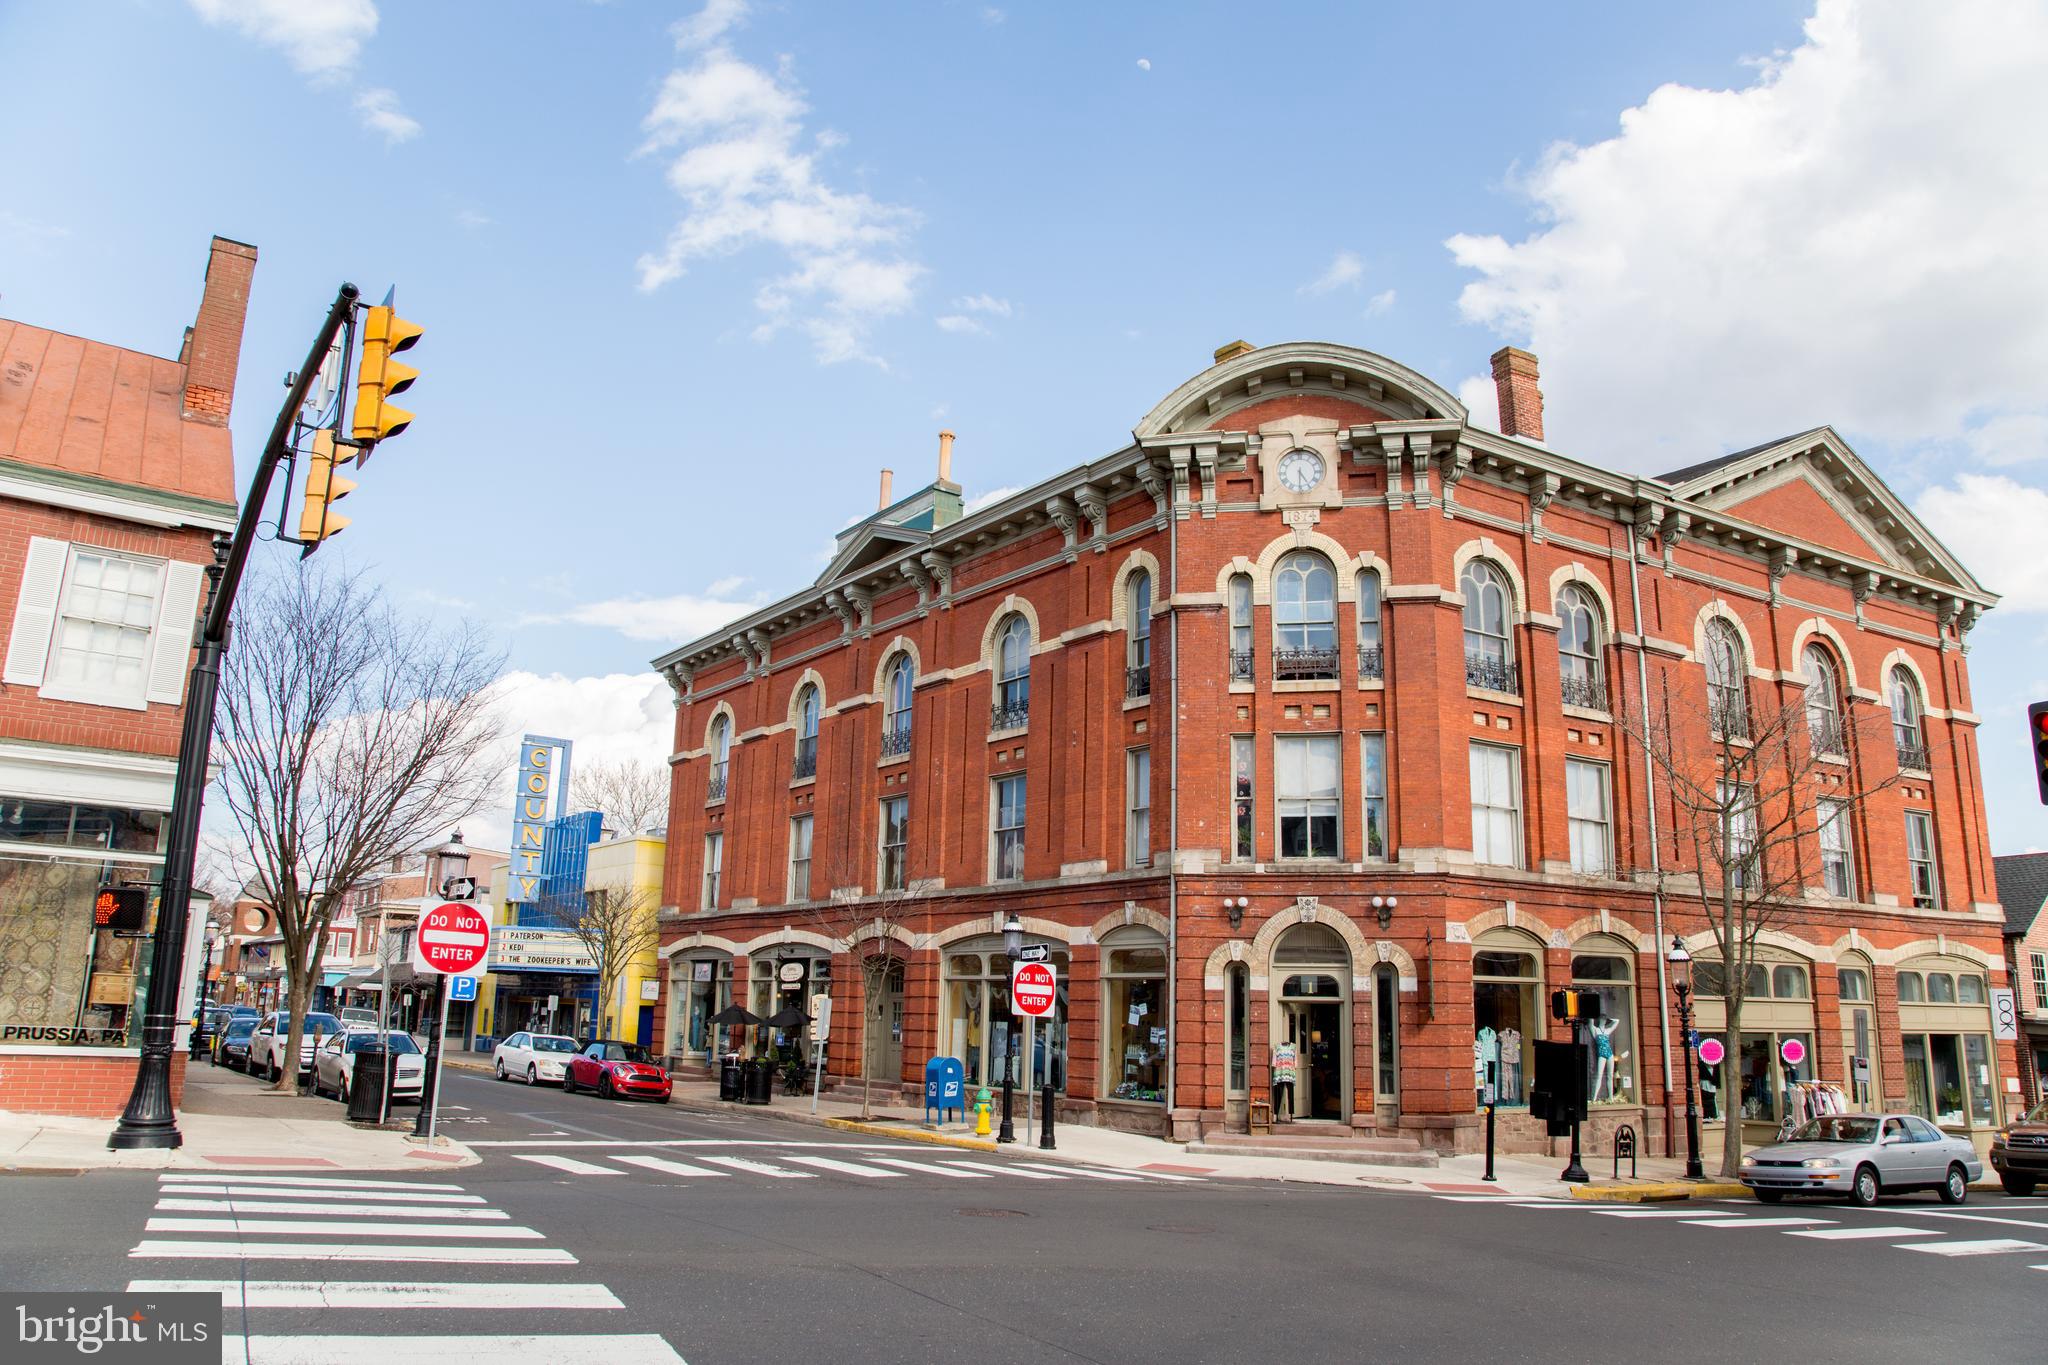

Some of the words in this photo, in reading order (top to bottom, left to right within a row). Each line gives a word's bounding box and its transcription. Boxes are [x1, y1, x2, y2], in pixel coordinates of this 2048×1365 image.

[1288, 511, 1317, 522] 1874
[520, 748, 548, 899] COUNTY
[430, 914, 448, 927] DO
[456, 917, 482, 929] NOT
[510, 932, 544, 940] PATERSON
[509, 943, 524, 951] KEDI
[431, 947, 473, 961] ENTER
[509, 955, 521, 963] THE
[527, 956, 571, 965] ZOOKEEPER'S
[576, 958, 592, 966] WIFE
[1020, 973, 1030, 981] DO
[1035, 974, 1050, 983] NOT
[458, 979, 471, 992] P
[1307, 981, 1314, 994] 1
[1022, 996, 1047, 1006] ENTER
[1997, 995, 2015, 1032] LOOK
[4, 1026, 94, 1043] PRUSSIA,
[102, 1030, 126, 1043] PA
